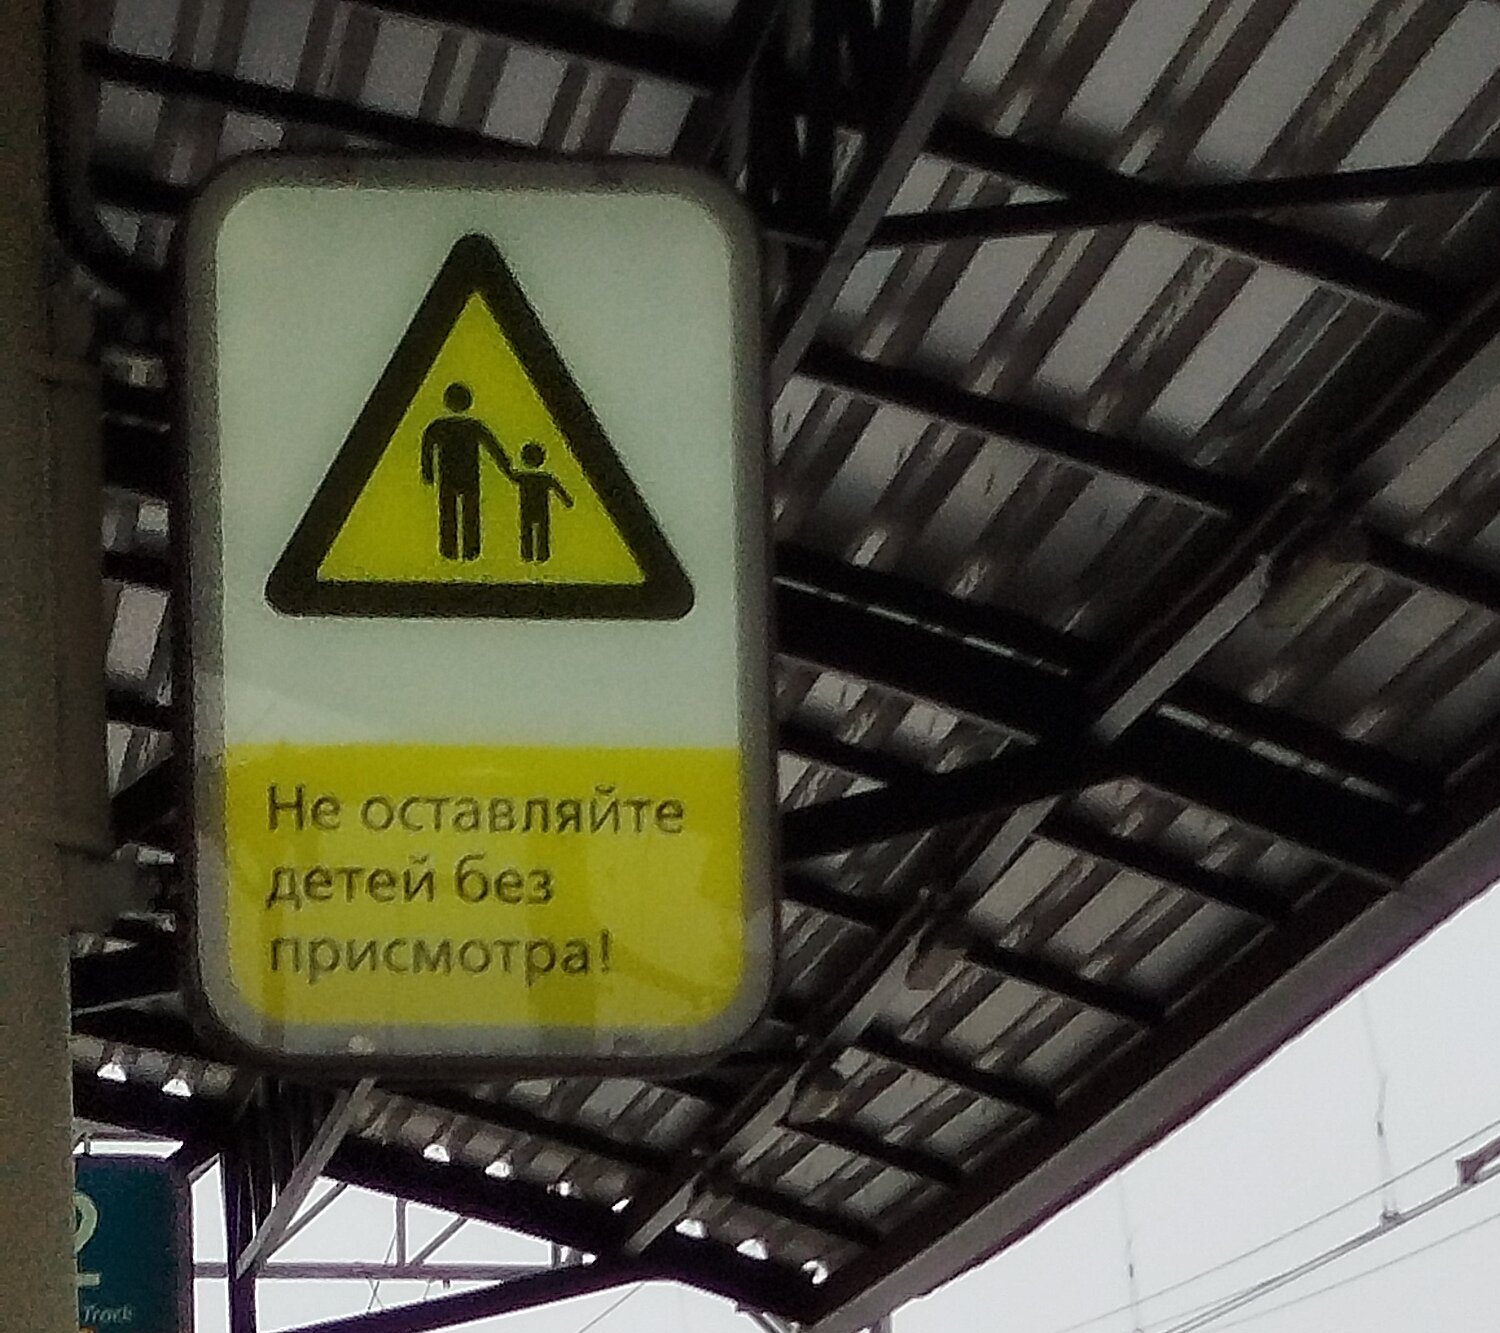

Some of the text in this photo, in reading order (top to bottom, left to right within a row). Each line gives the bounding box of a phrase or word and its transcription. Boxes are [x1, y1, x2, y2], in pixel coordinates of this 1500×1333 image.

[266, 784, 685, 834] Не оставляйте
[265, 854, 554, 910] детей без
[269, 930, 612, 986] присмотра!
